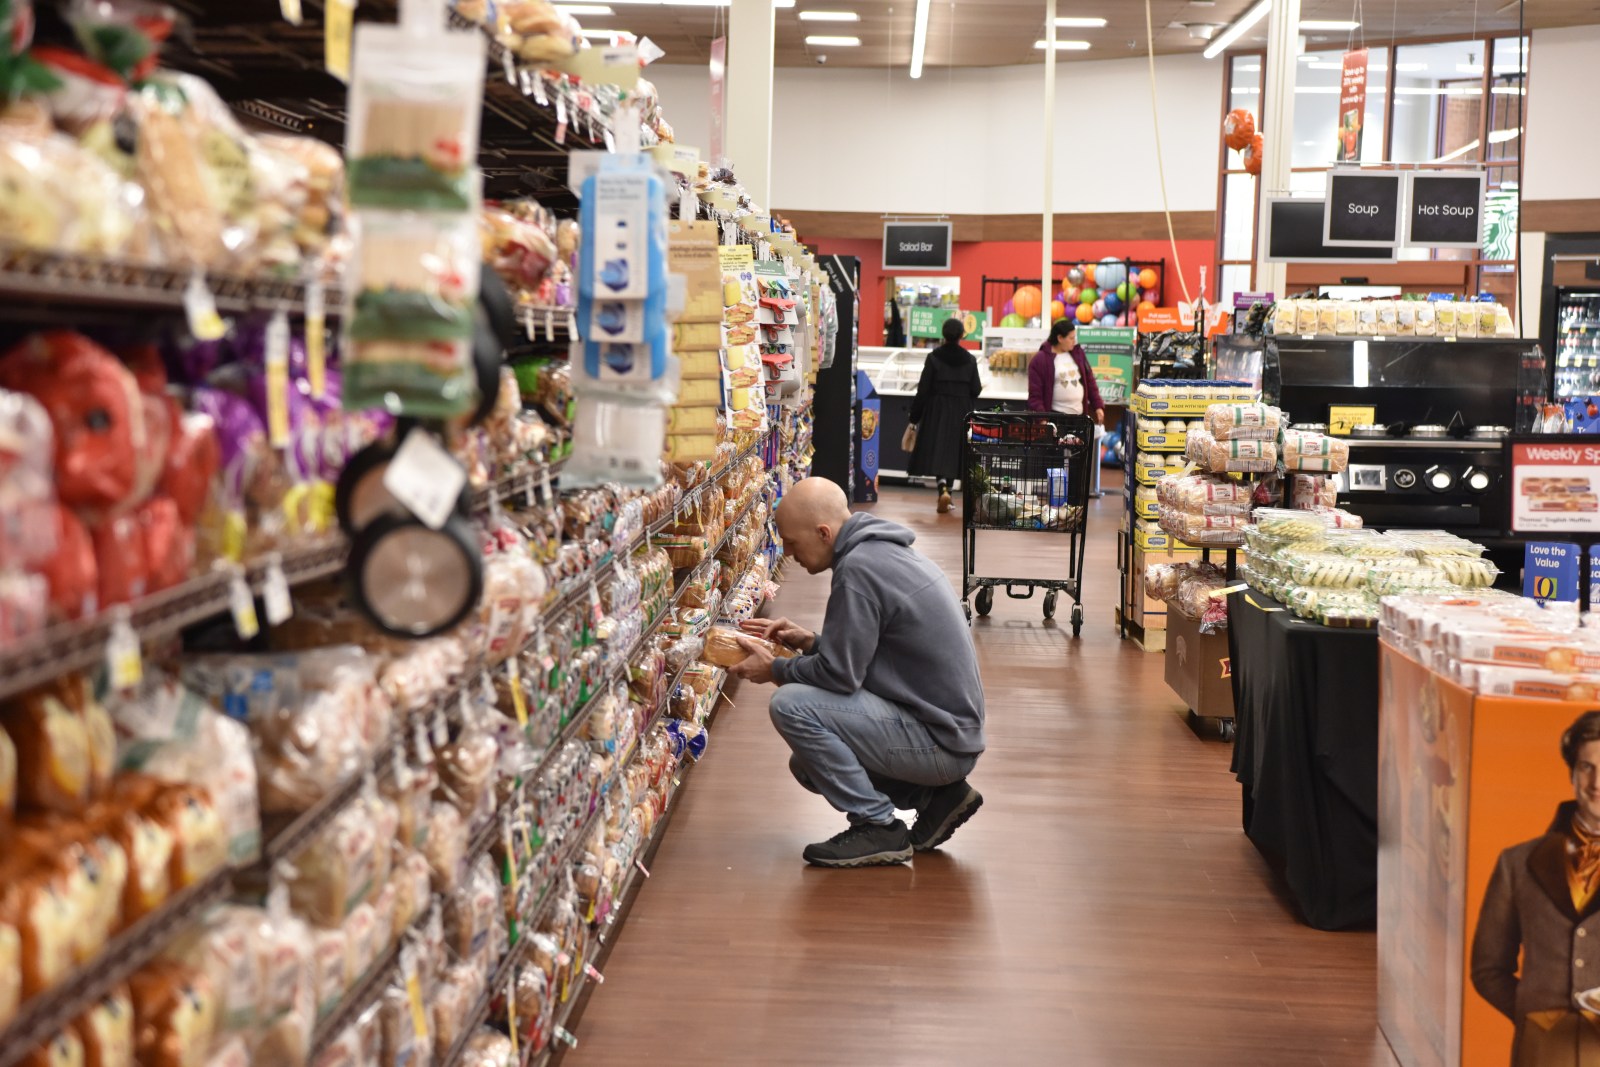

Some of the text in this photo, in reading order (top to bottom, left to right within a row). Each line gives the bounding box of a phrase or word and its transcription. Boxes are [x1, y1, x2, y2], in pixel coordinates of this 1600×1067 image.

[1348, 203, 1379, 217] Soup
[1418, 204, 1474, 218] Hot Soup
[899, 241, 933, 252] Salad Bar
[1526, 447, 1581, 464] Weekly
[1530, 544, 1566, 556] Love the
[1535, 557, 1560, 568] Value
